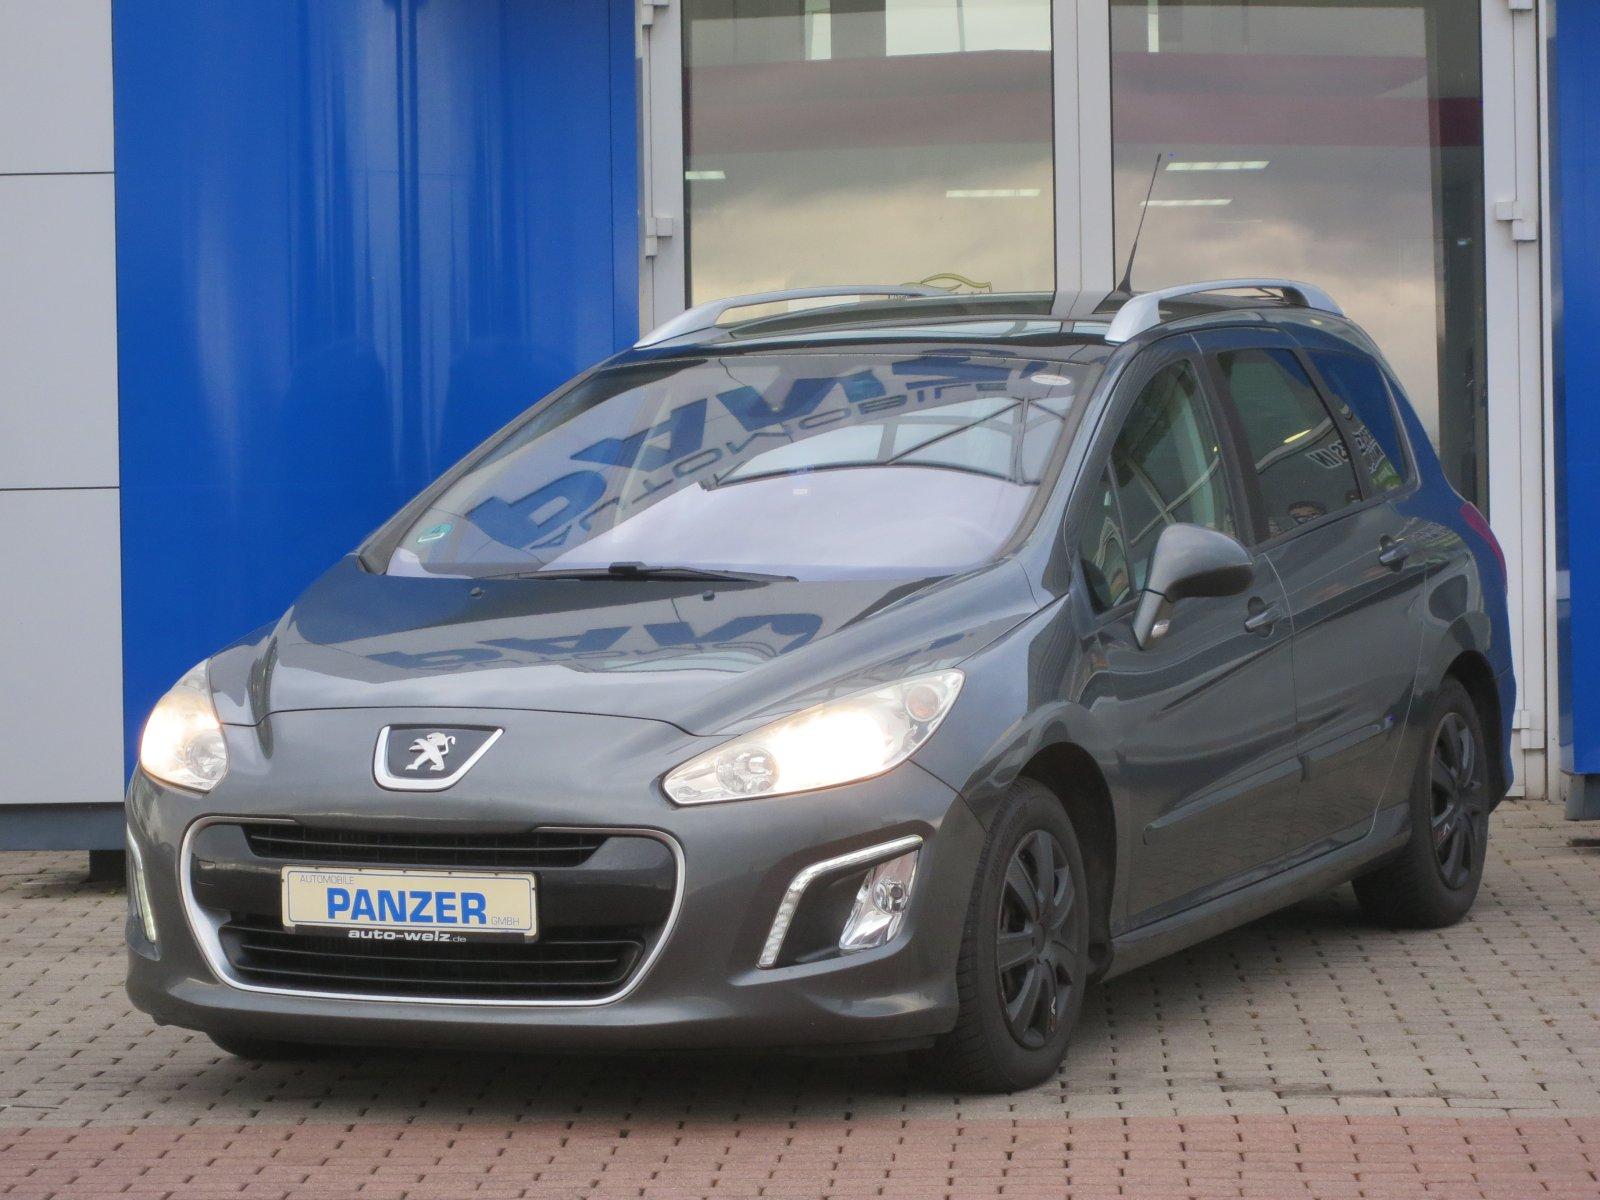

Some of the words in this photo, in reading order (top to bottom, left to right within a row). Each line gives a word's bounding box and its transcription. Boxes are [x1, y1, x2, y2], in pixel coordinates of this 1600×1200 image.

[299, 874, 355, 885] AUTOMOBILE
[326, 887, 488, 924] PANZER
[490, 915, 520, 926] GMBH
[347, 929, 467, 943] auto-welz.de
